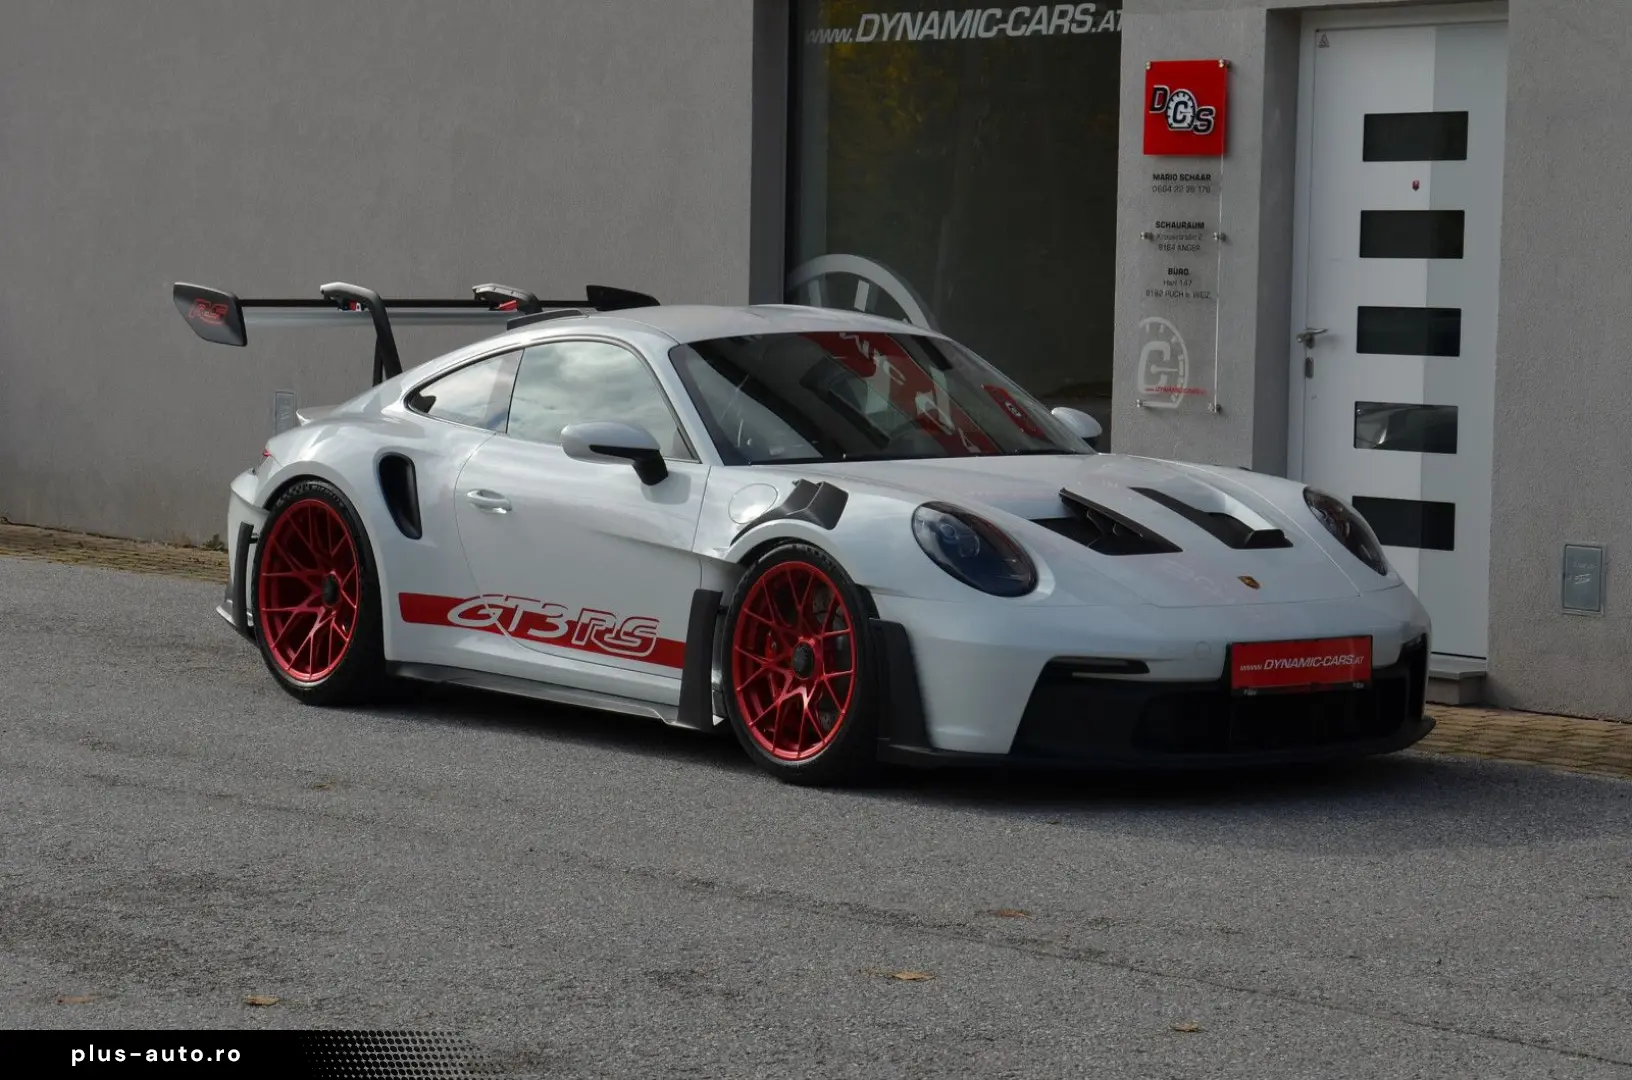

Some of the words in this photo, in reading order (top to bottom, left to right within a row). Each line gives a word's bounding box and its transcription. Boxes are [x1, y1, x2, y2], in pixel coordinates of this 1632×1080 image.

[1152, 173, 1178, 181] MARIO
[1180, 173, 1211, 181] SCHAAR
[1155, 221, 1205, 229] SCHAURAUM
[446, 593, 570, 639] GT3
[571, 607, 661, 657] RS
